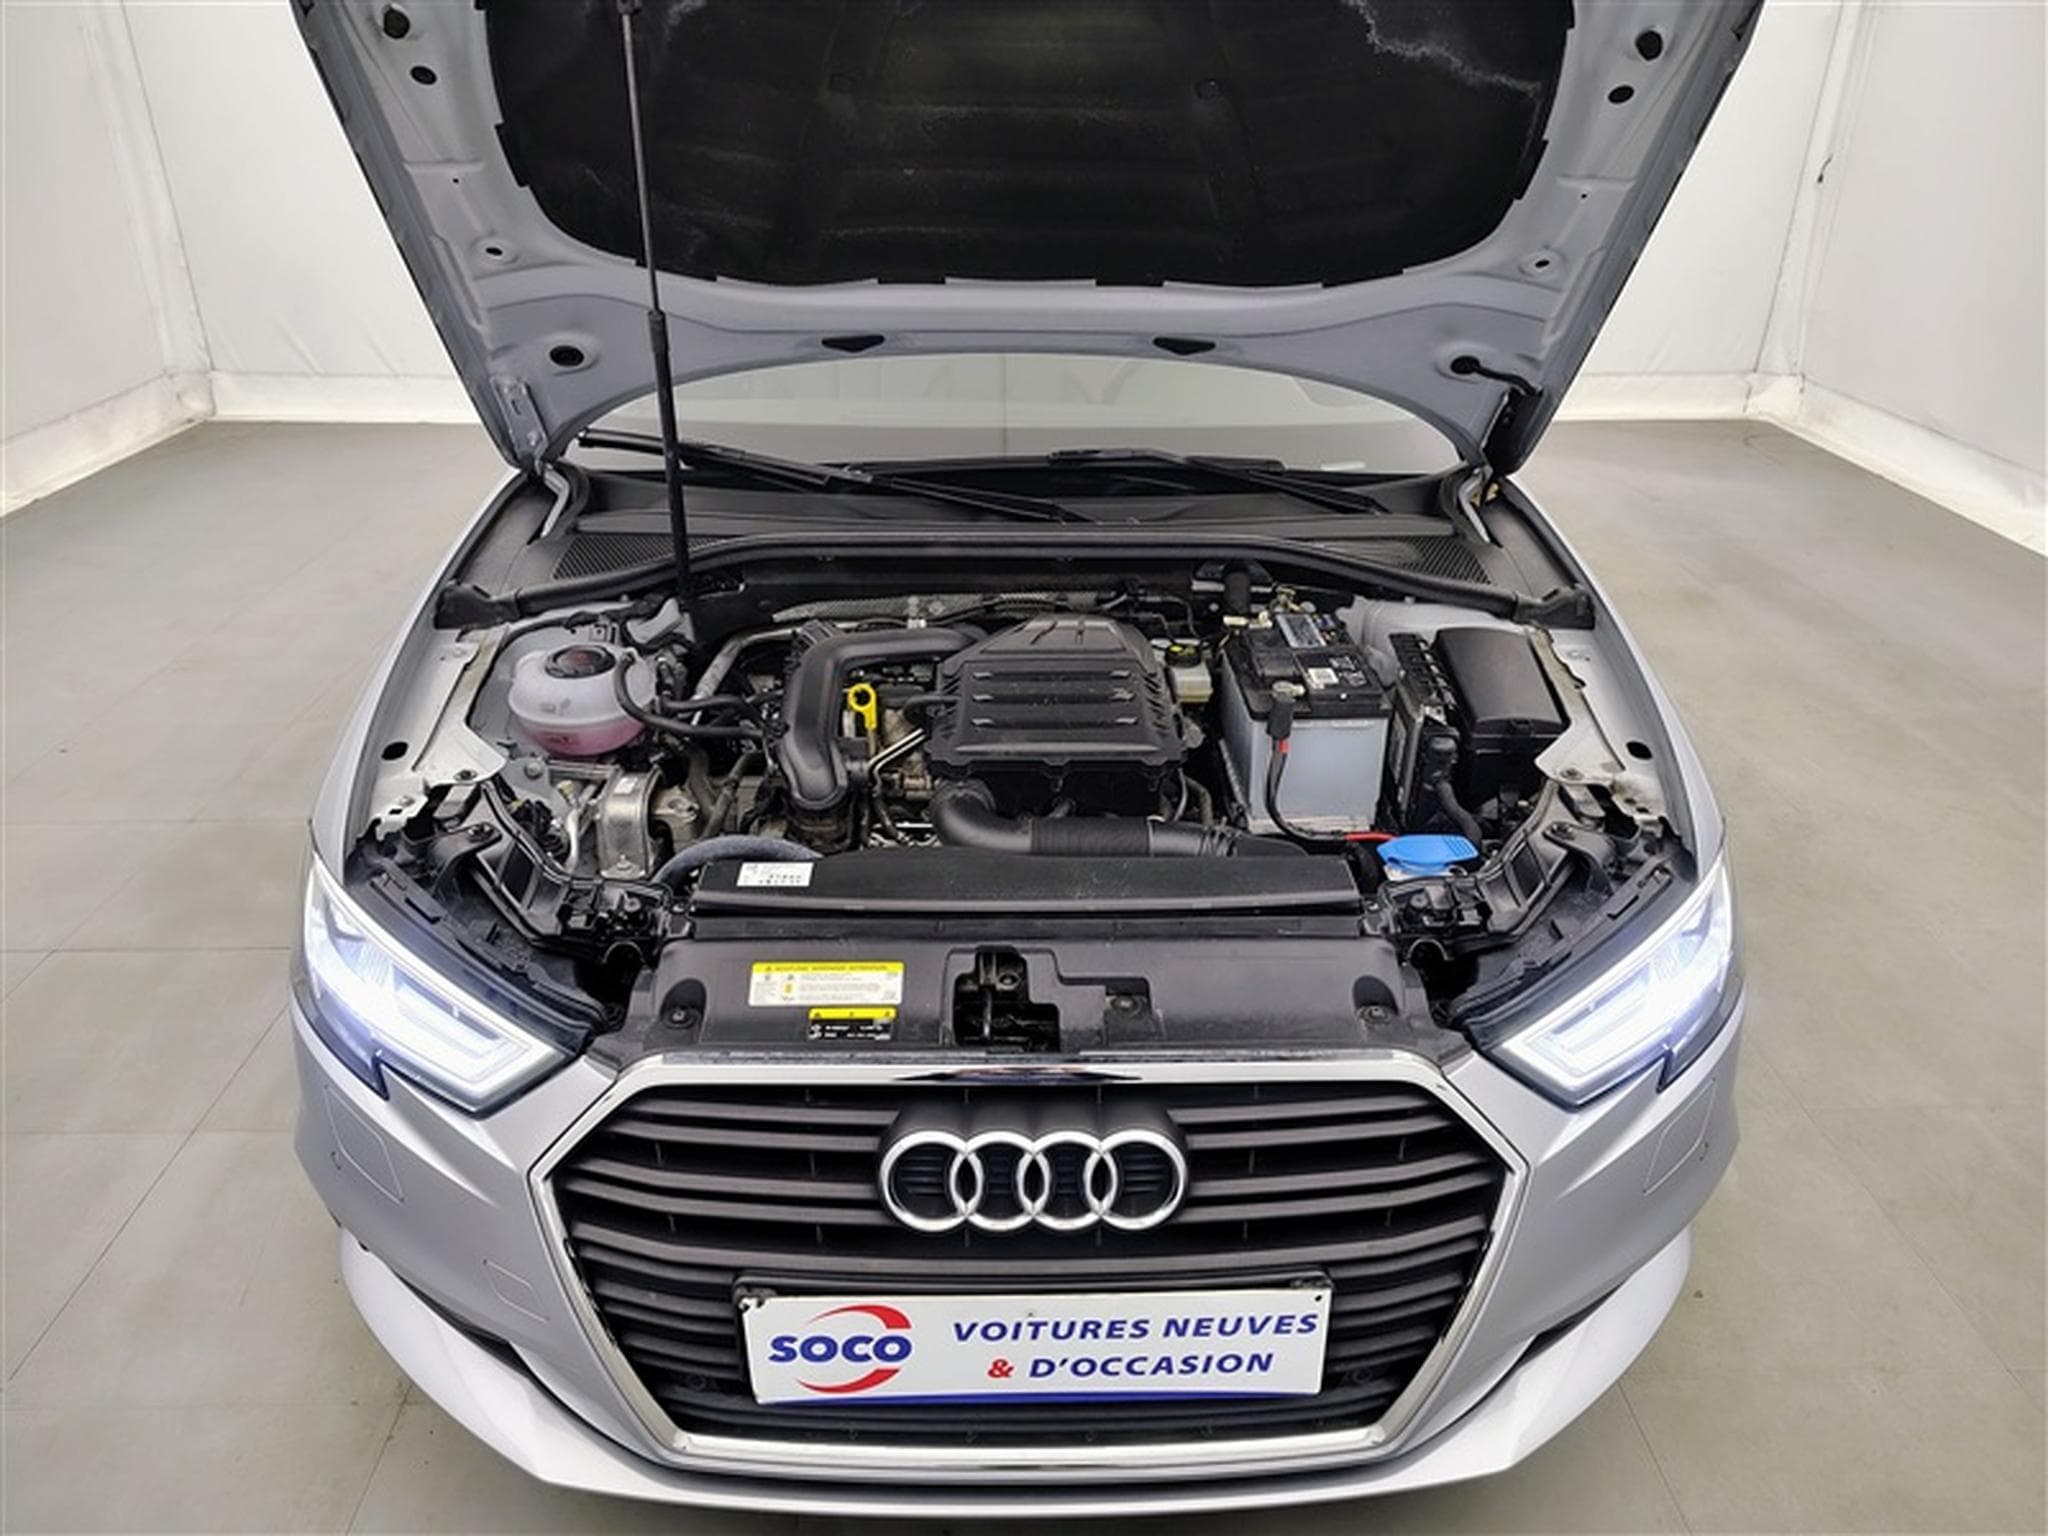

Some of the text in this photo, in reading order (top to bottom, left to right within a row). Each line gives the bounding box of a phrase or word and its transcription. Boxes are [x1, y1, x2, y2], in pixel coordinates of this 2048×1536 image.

[953, 1313, 1319, 1342] VOITURES NEUVES
[768, 1335, 913, 1363] SOCO
[987, 1352, 1274, 1379] & D'OCCASION
